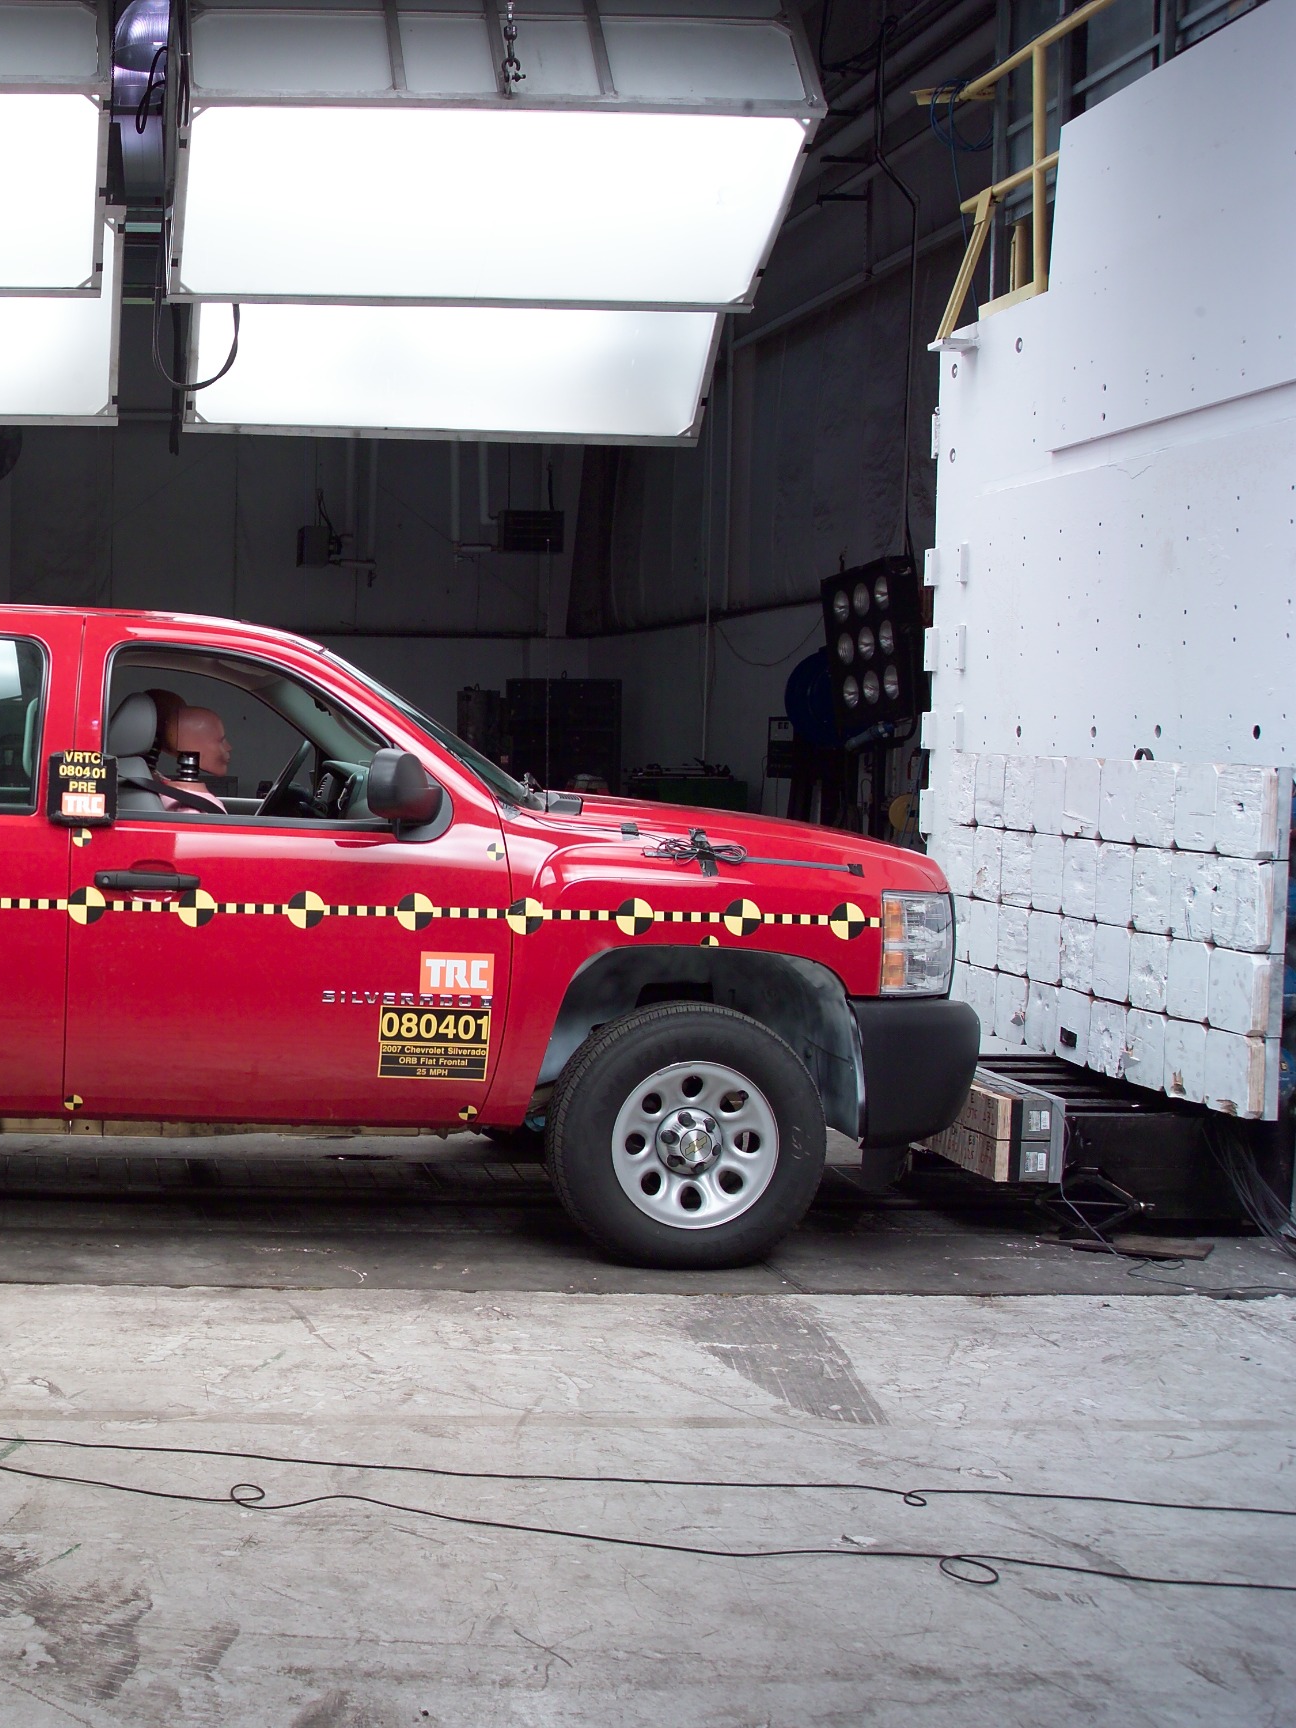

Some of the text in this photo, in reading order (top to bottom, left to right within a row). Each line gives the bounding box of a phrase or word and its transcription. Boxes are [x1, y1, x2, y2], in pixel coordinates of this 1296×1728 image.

[65, 751, 101, 764] VRTC
[69, 781, 97, 793] PRE
[64, 796, 103, 814] TRC
[425, 958, 489, 989] TRC
[322, 990, 472, 1007] SILVERADO
[381, 1012, 488, 1040] 080401
[382, 1045, 486, 1056] 2007 Chevrolet Silverado
[398, 1056, 468, 1066] ORB Flat Frontal
[416, 1068, 449, 1076] 25 MPH
